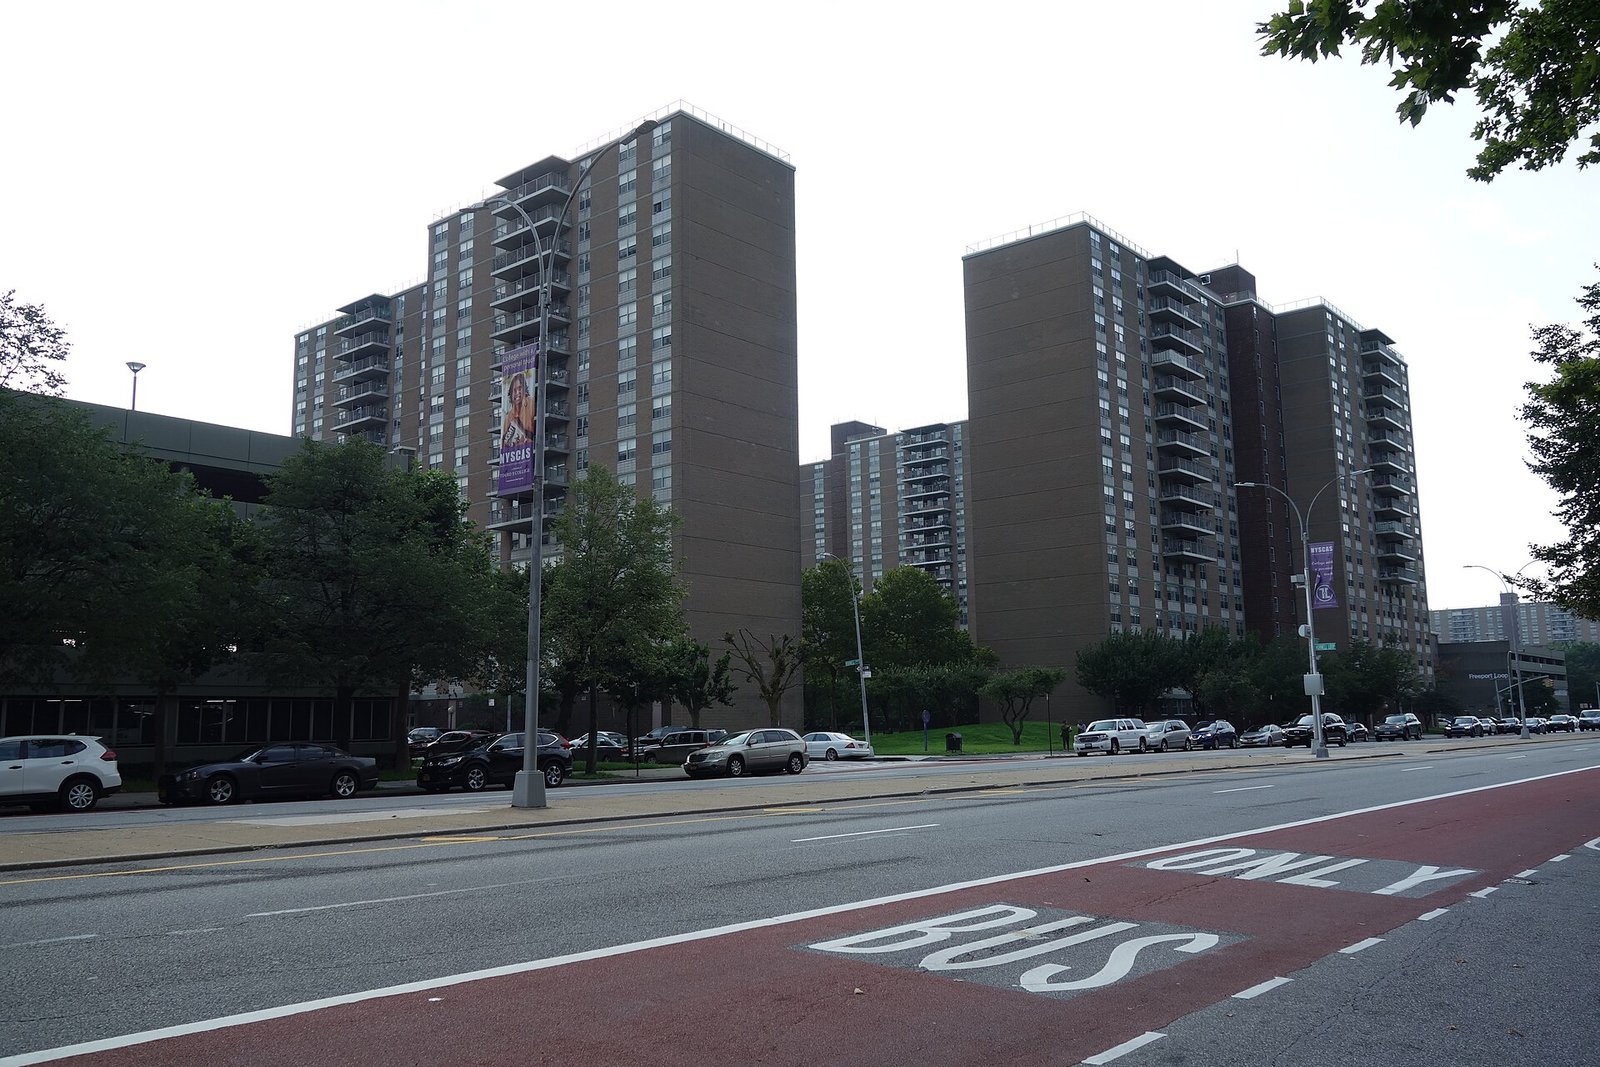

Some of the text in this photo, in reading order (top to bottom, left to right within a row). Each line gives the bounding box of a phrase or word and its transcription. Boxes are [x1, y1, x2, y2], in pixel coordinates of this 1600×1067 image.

[502, 352, 519, 363] College
[504, 359, 522, 373] personal
[500, 448, 531, 464] NYSCAS
[1146, 848, 1477, 896] ONLY
[807, 904, 1219, 992] BUS
